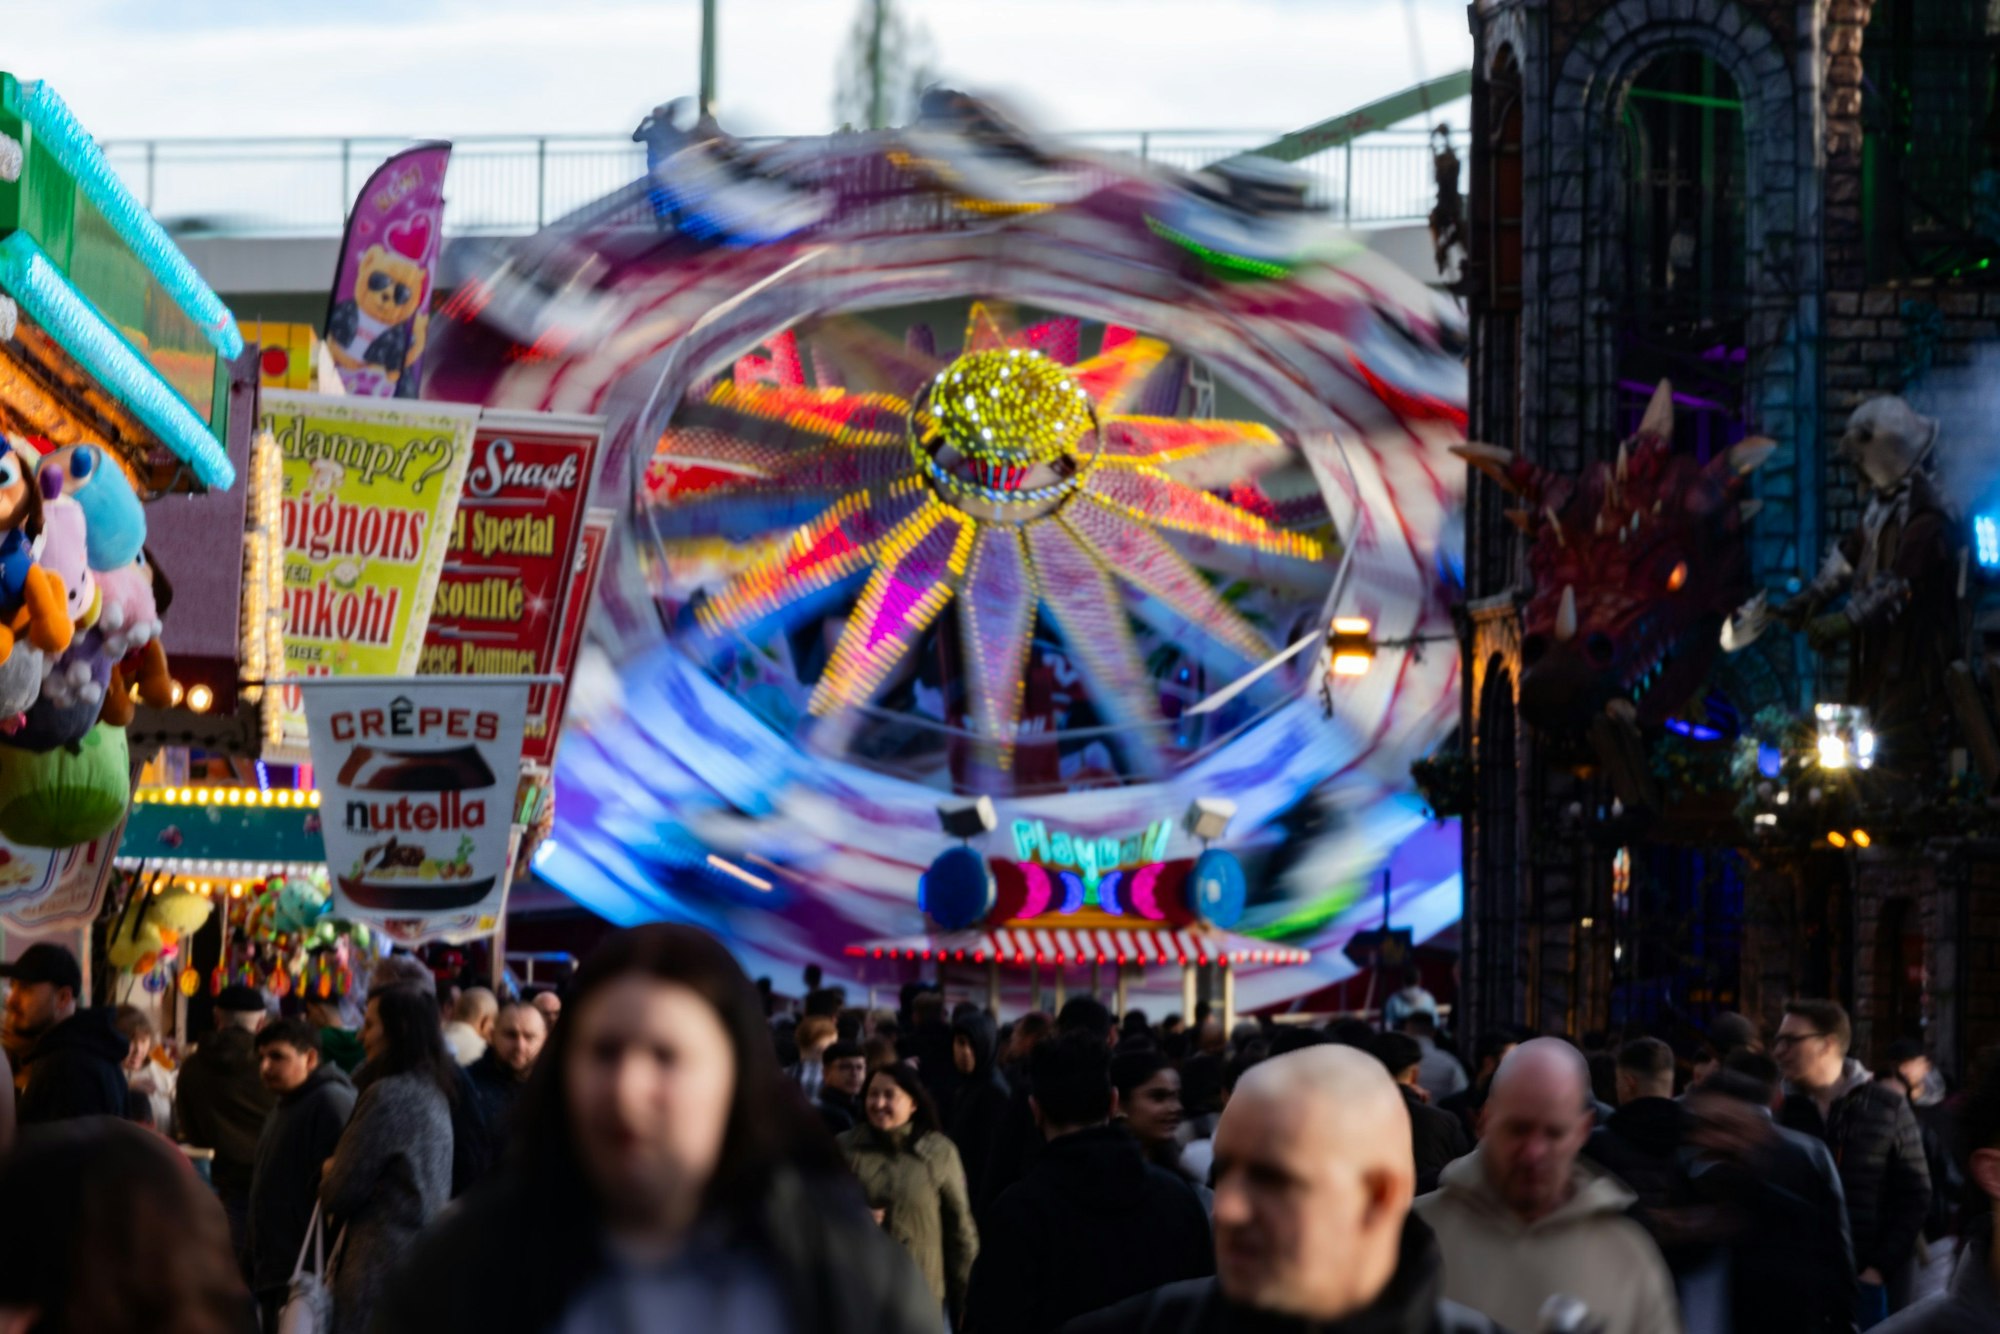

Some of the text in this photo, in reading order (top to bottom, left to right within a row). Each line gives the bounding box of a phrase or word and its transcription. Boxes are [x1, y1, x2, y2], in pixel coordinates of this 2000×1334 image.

[470, 437, 579, 498] Snack
[472, 511, 556, 558] Spezial
[461, 640, 537, 676] Pommes
[330, 695, 499, 743] CRÊPES
[345, 790, 486, 832] nutella
